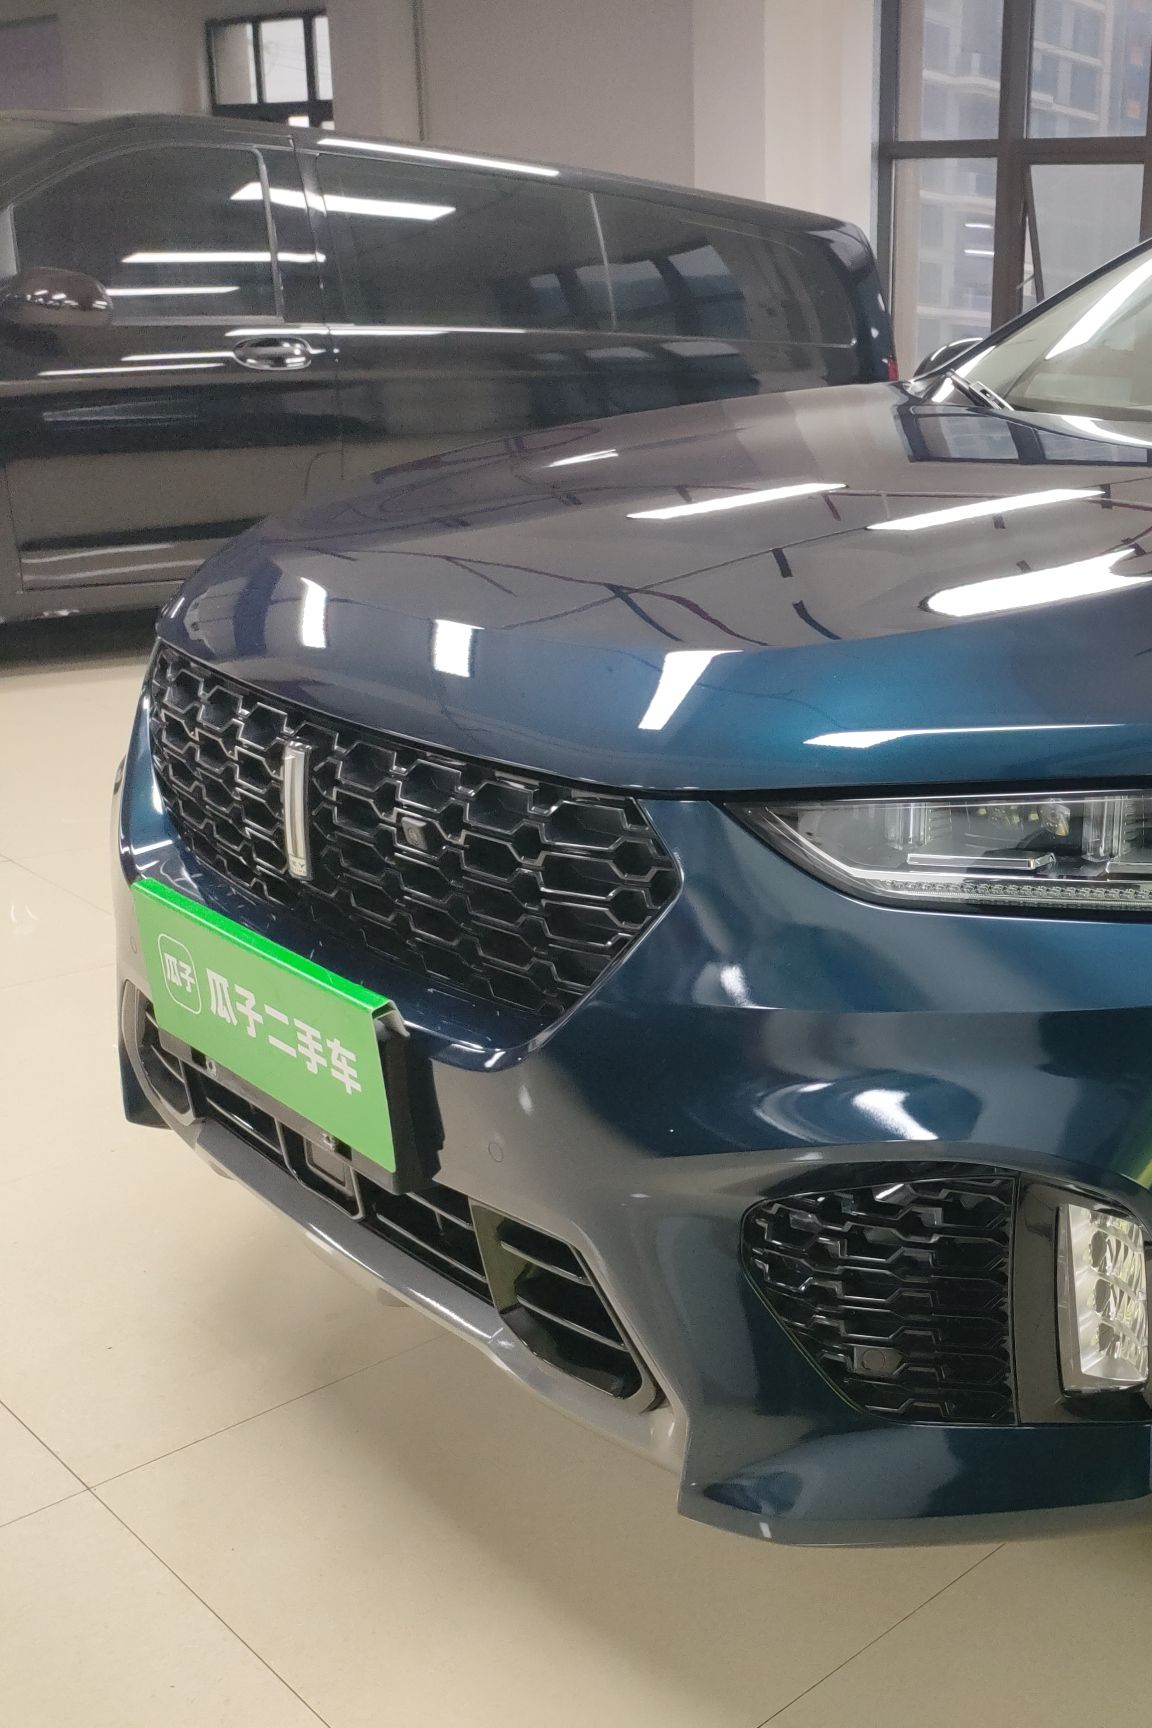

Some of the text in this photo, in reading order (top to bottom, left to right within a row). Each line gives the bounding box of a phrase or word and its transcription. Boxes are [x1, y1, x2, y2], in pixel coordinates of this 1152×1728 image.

[163, 952, 196, 993] 瓜子
[206, 967, 362, 1095] 瓜子二手车
